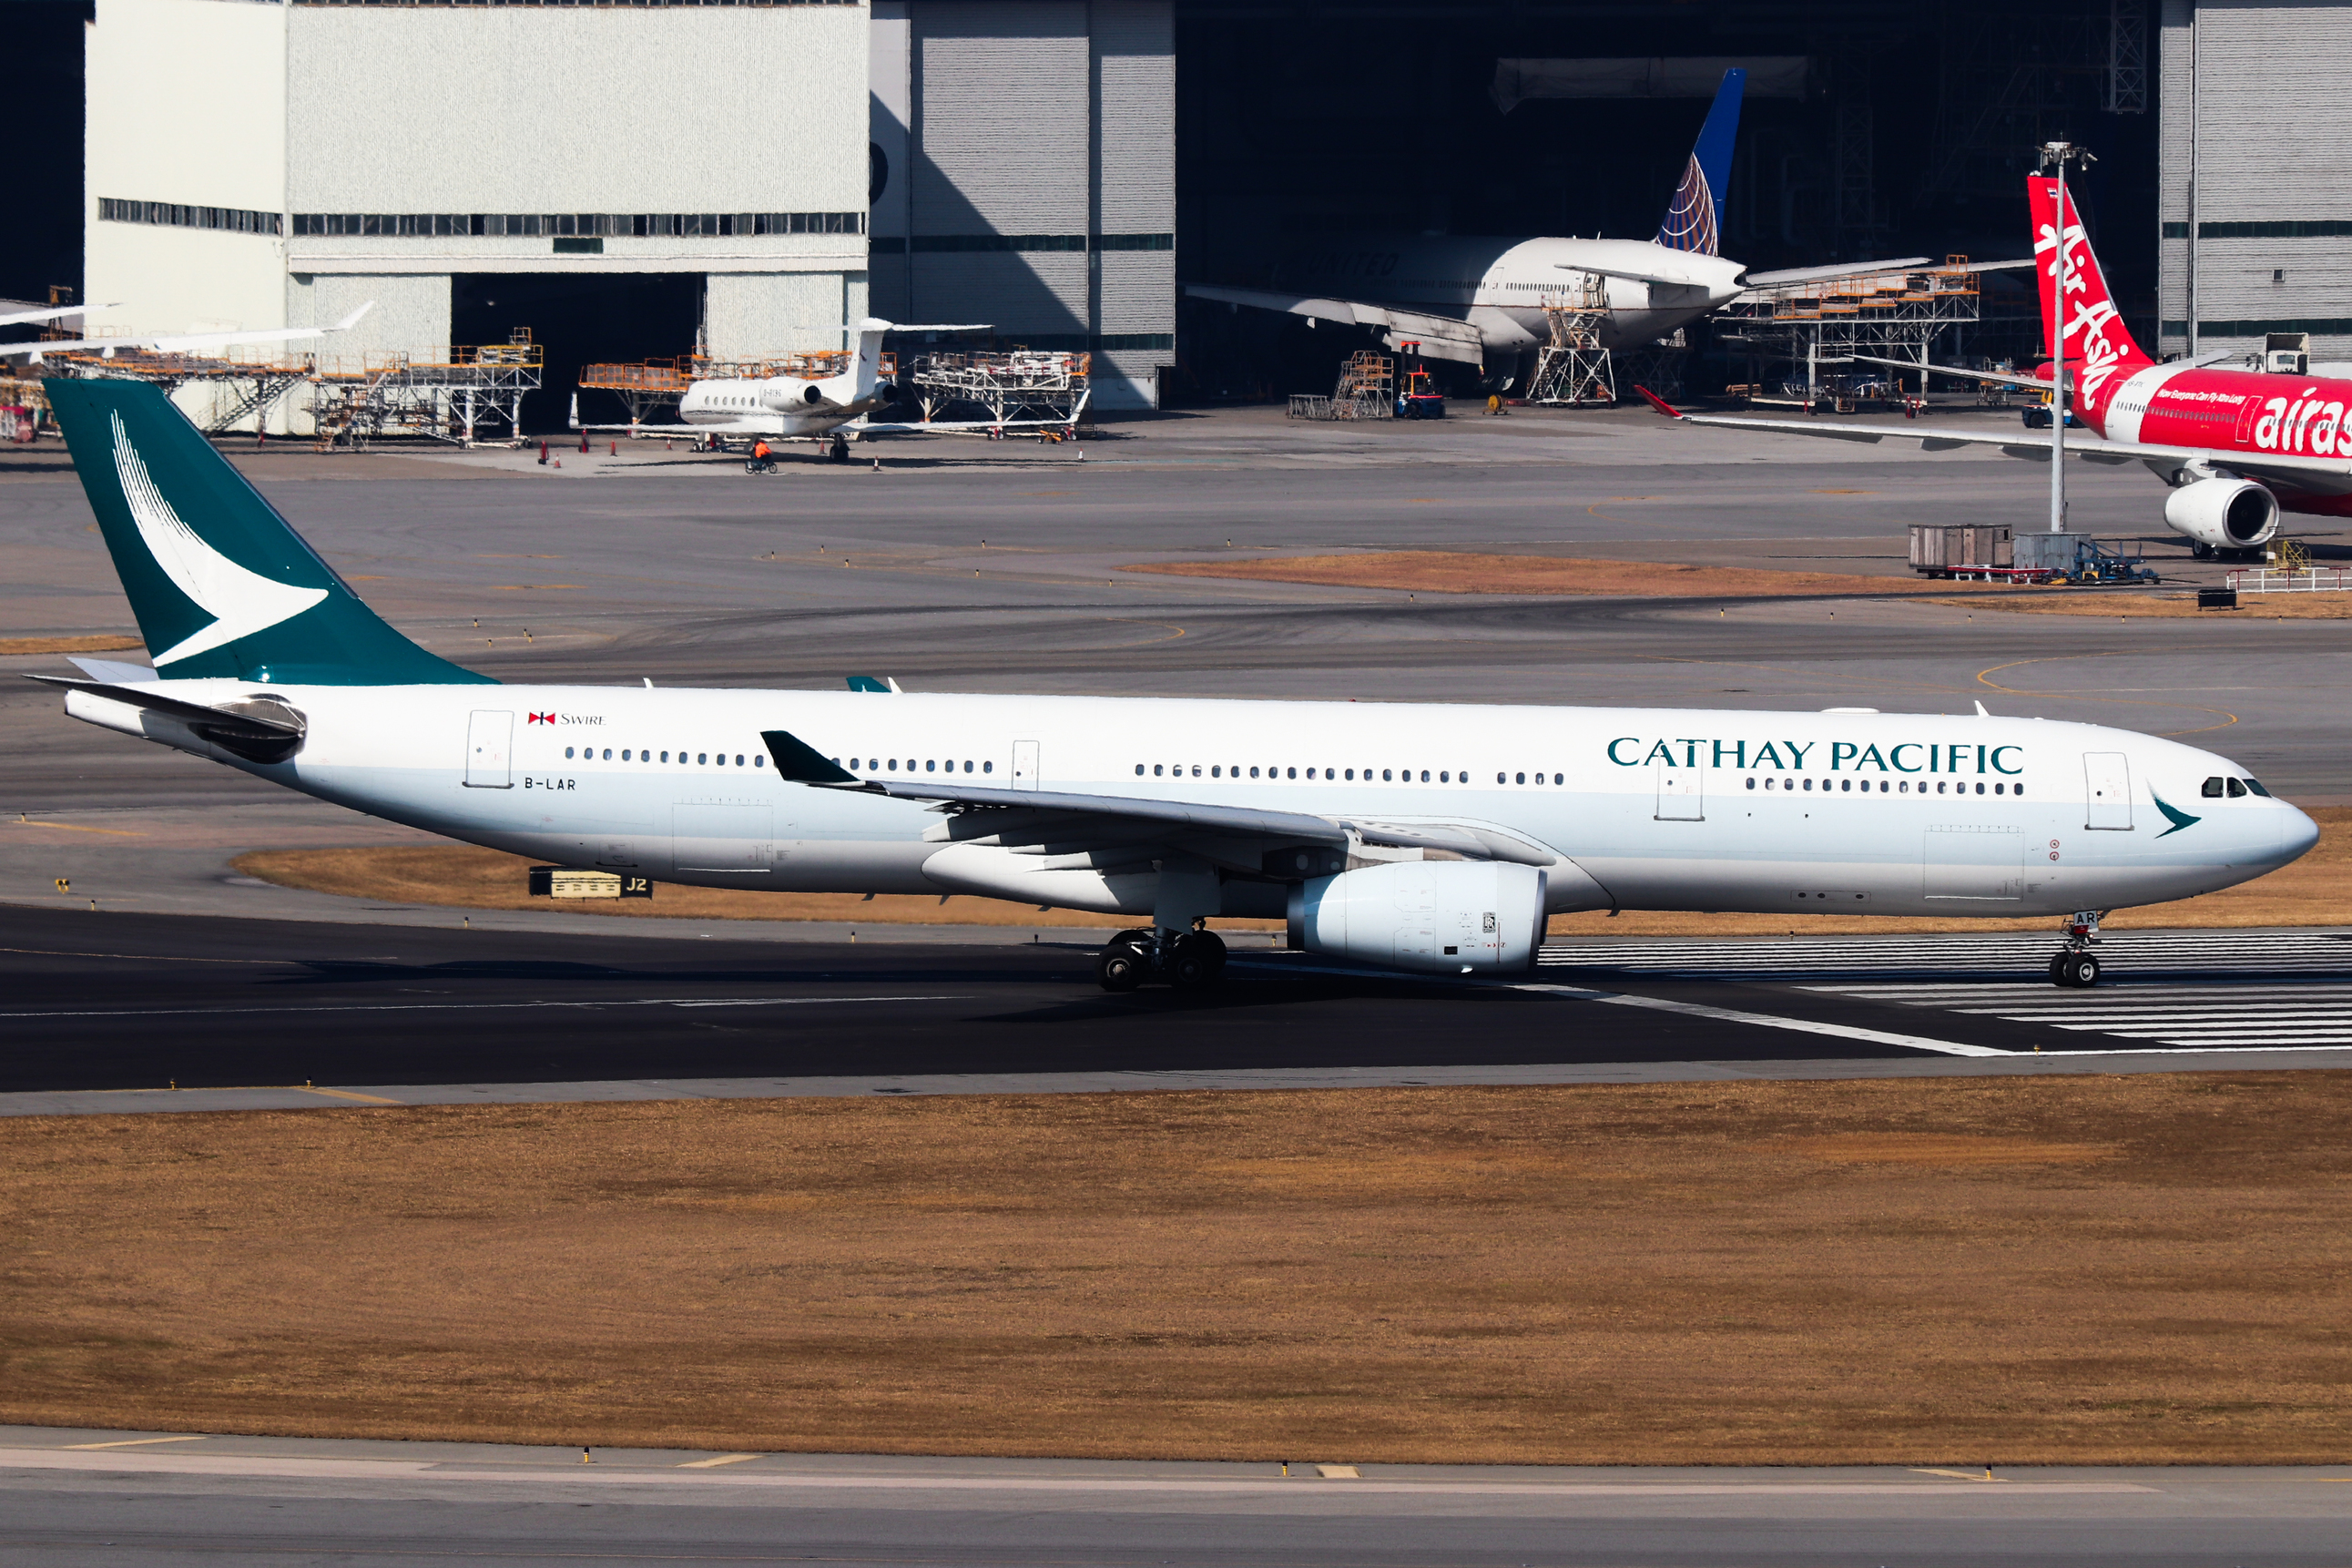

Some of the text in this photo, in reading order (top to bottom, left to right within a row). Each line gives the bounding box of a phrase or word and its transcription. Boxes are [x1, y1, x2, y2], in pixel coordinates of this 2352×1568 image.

[1607, 738, 2023, 775] CATHAY PACIFIC
[524, 777, 575, 790] B-LAR
[626, 877, 647, 891] J2
